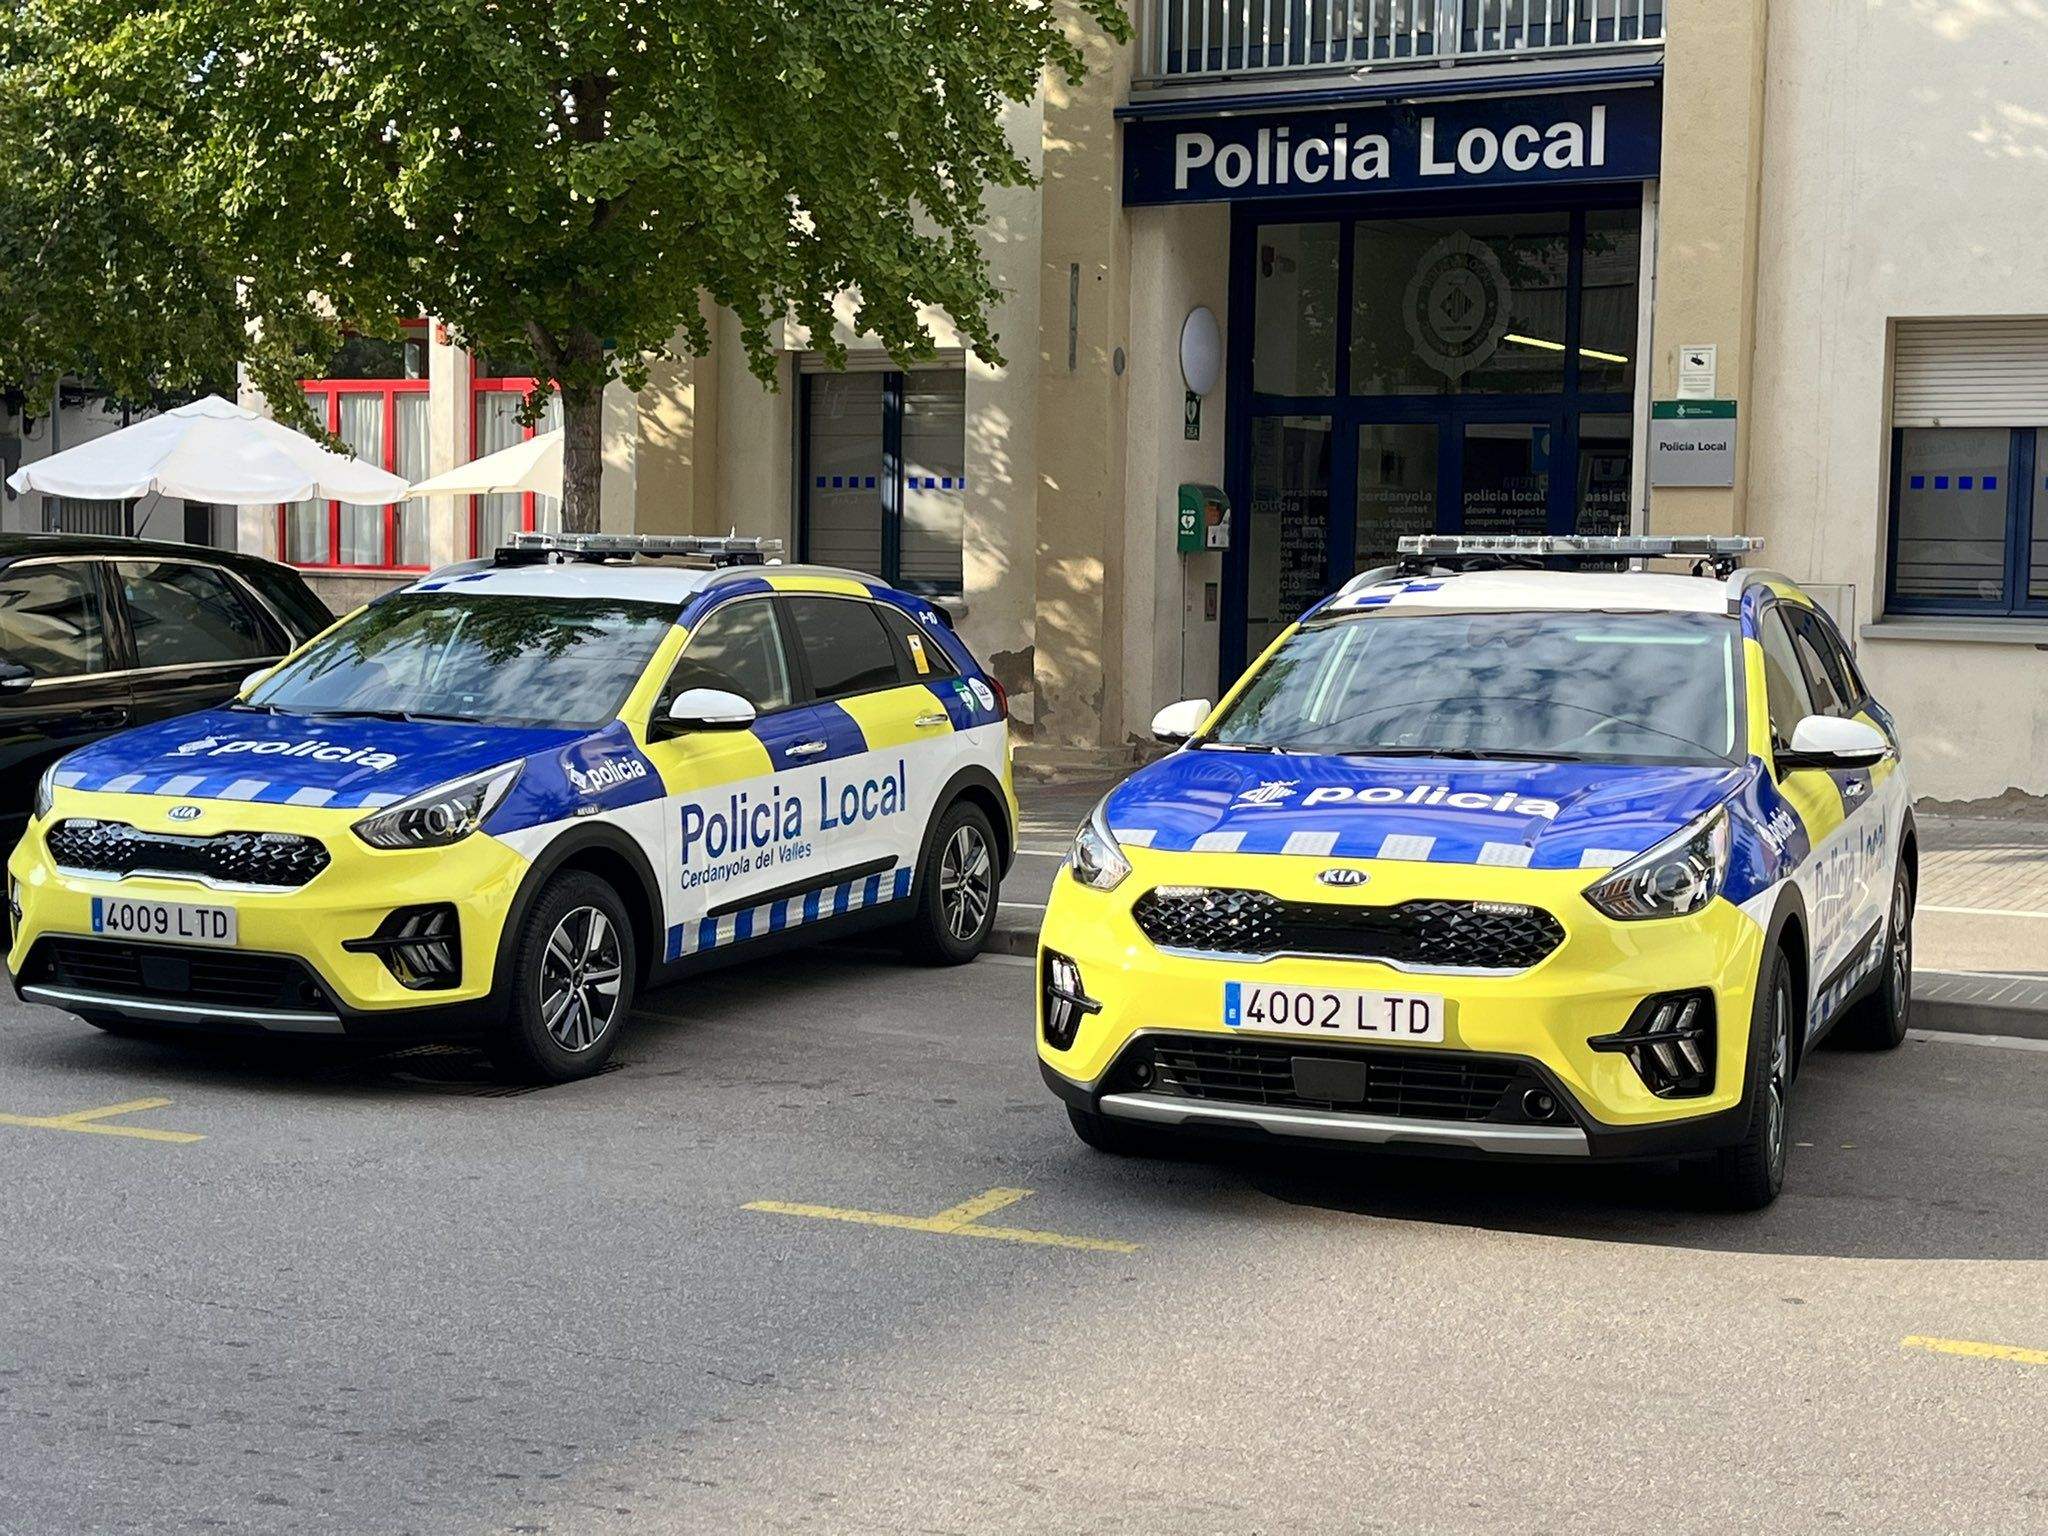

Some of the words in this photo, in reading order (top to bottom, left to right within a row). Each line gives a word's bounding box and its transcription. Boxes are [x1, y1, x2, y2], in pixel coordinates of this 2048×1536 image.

[1174, 123, 1390, 190] Policia
[1420, 105, 1607, 175] Local
[1659, 441, 1695, 452] Policia
[1698, 441, 1727, 451] Local
[1464, 489, 1509, 504] policia
[1511, 488, 1546, 502] local
[207, 739, 398, 771] policia
[586, 757, 647, 791] policia
[170, 807, 198, 818] KIA
[680, 786, 802, 865] Policia
[820, 759, 906, 831] Local
[1301, 785, 1561, 820] policia
[681, 855, 750, 890] Cerdanyola
[755, 848, 774, 869] del
[1323, 869, 1361, 883] KIA
[106, 902, 169, 935] 4009
[178, 907, 228, 939] LTD
[1246, 988, 1342, 1029] 4002
[1357, 995, 1430, 1034] LTD
